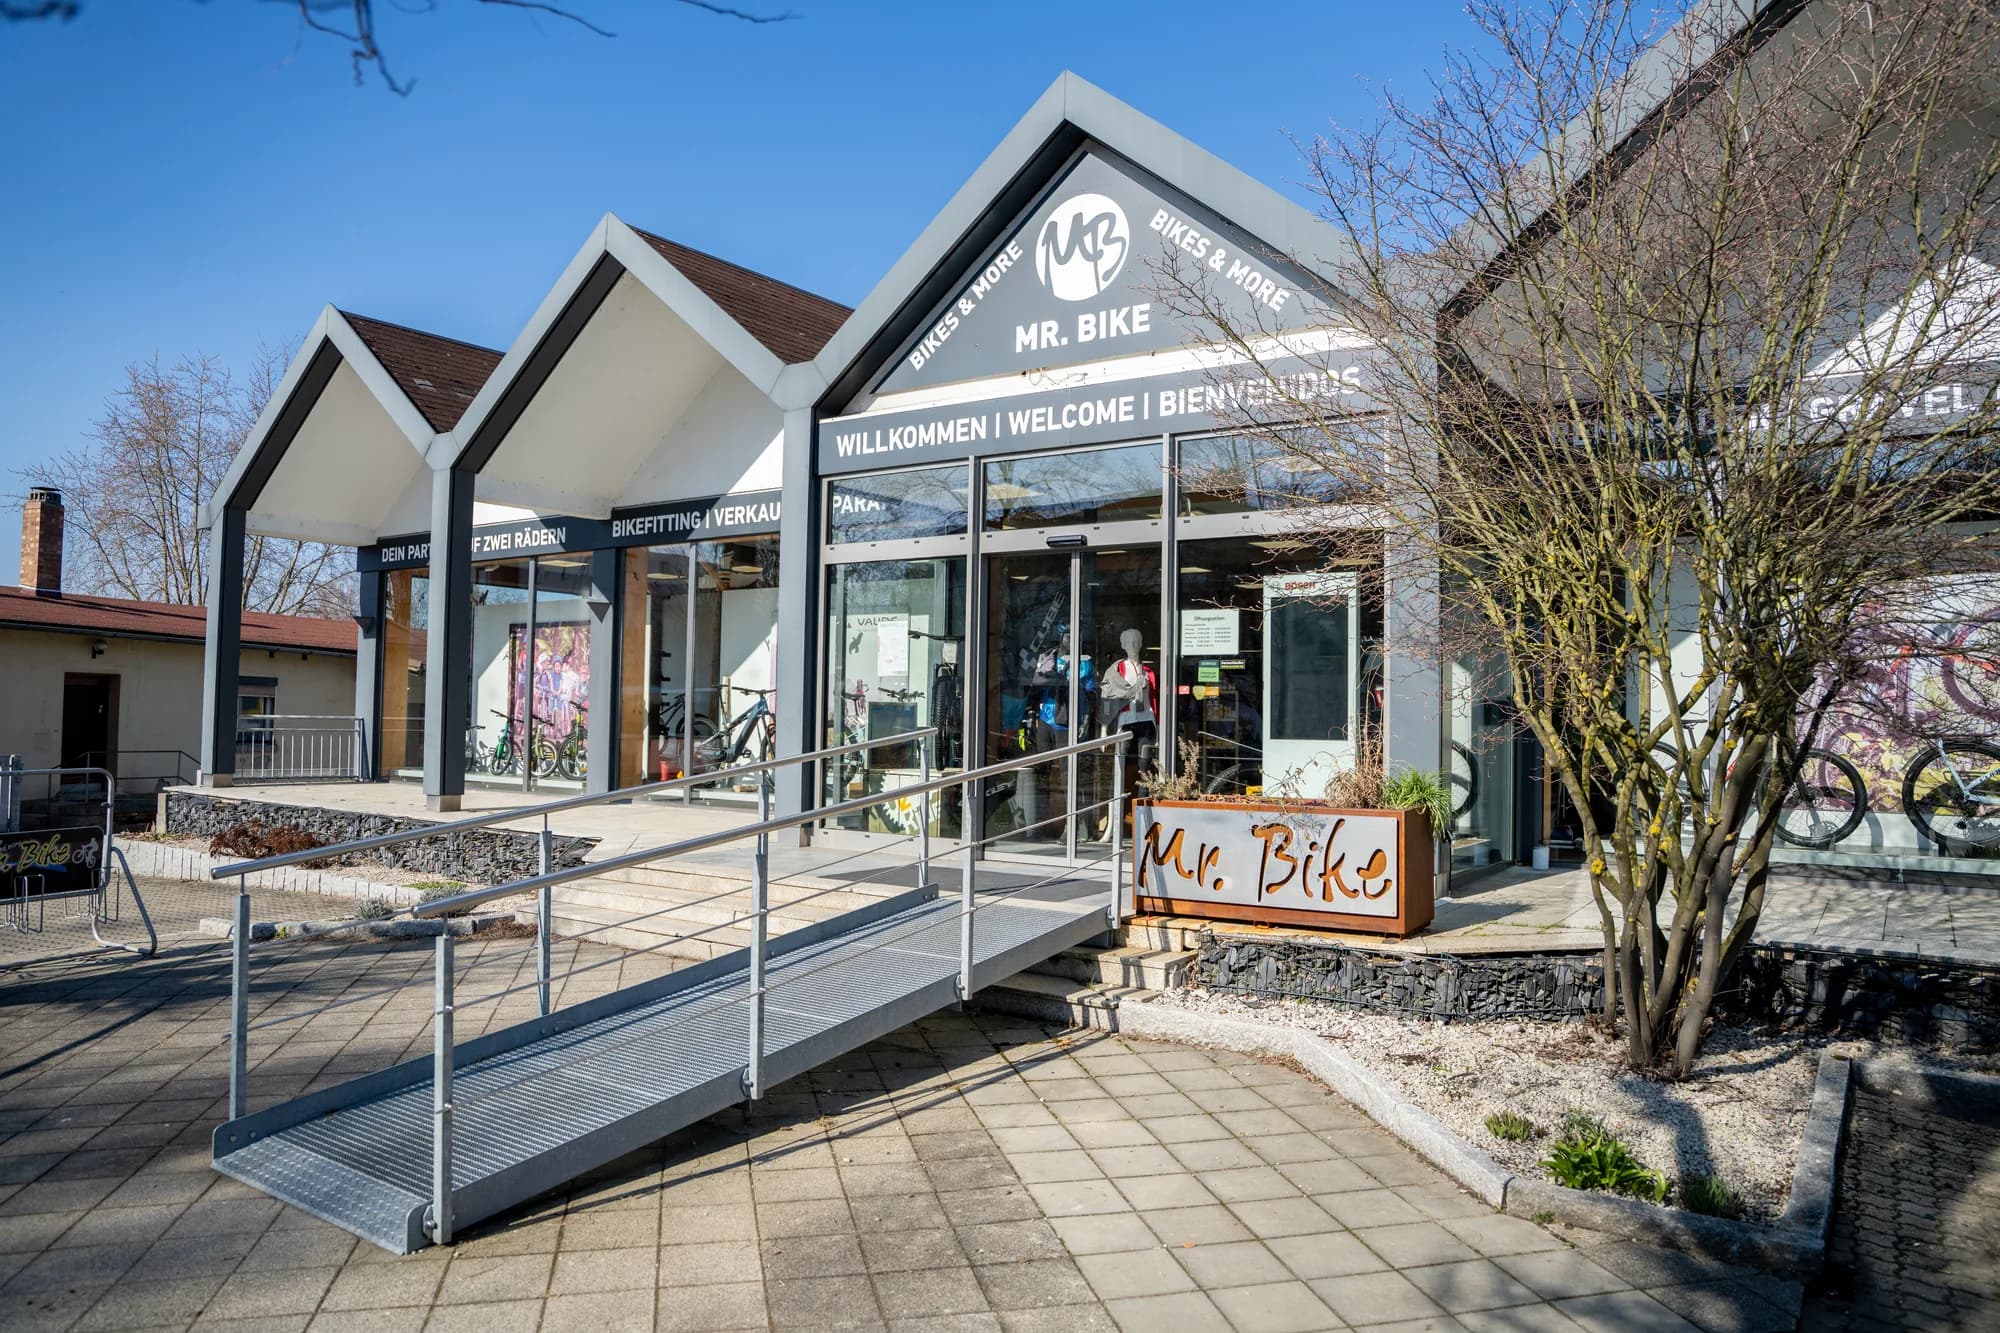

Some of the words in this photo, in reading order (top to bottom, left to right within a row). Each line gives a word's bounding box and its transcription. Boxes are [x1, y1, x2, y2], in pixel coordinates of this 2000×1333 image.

[1149, 208, 1211, 258] BIKES
[1209, 248, 1226, 272] &
[1226, 258, 1291, 312] MORE
[909, 312, 959, 371] BIKES
[958, 298, 976, 316] &
[971, 240, 1024, 300] MORE
[1015, 320, 1069, 353] MR.
[1078, 303, 1151, 343] BIKE
[836, 415, 987, 457] WILLKOMMEN
[1008, 395, 1135, 435] WELCOME
[382, 546, 405, 563] DEIN
[483, 533, 511, 552] ZWEI
[514, 527, 567, 549] RÄDERN
[612, 511, 701, 538] BIKEFITTING
[714, 501, 781, 526] VERKAU
[17, 833, 70, 873] Bike
[1137, 821, 1225, 891] Mr.
[1251, 818, 1393, 903] Bike
